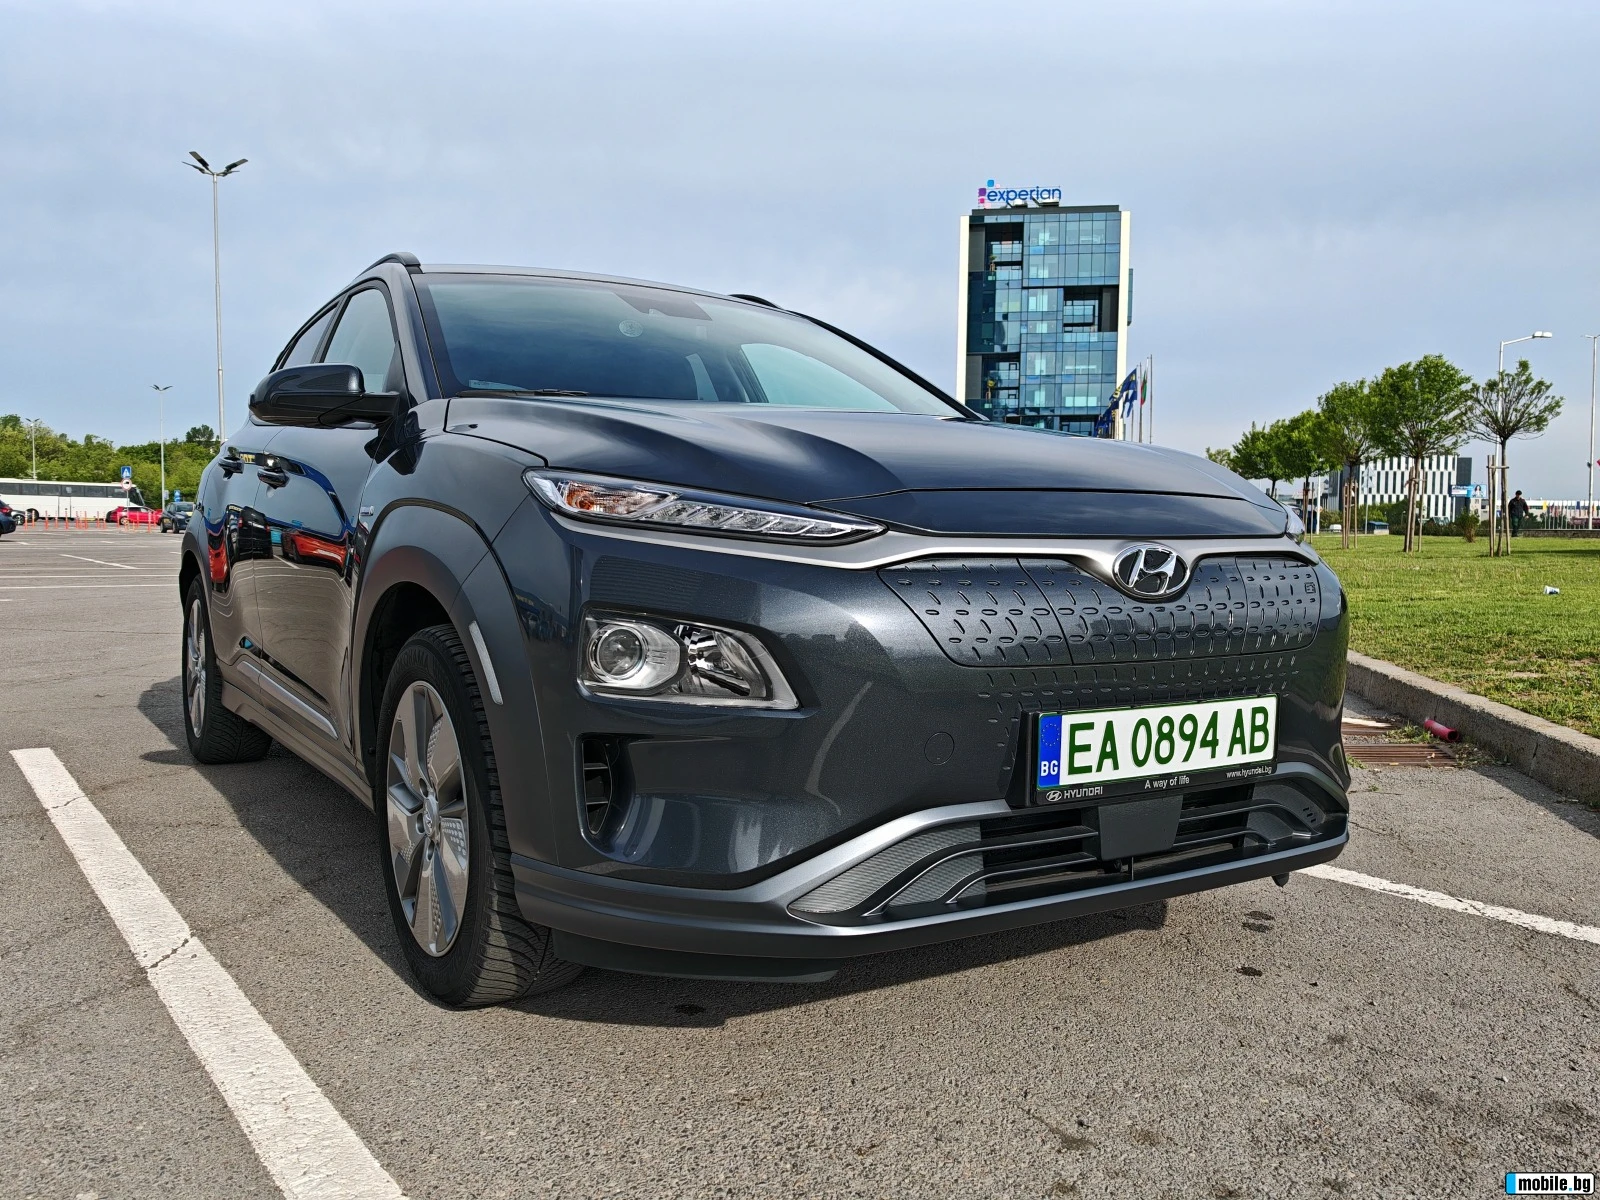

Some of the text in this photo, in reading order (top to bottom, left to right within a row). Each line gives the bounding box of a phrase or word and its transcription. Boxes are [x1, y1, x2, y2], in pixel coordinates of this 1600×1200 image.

[987, 186, 1061, 204] experian
[1067, 706, 1270, 775] EA 0894 AB
[1041, 760, 1058, 776] BG
[1226, 766, 1272, 778] www.hyundai.bg
[1144, 775, 1190, 789] A way of life
[1064, 786, 1103, 799] HYUNDAI
